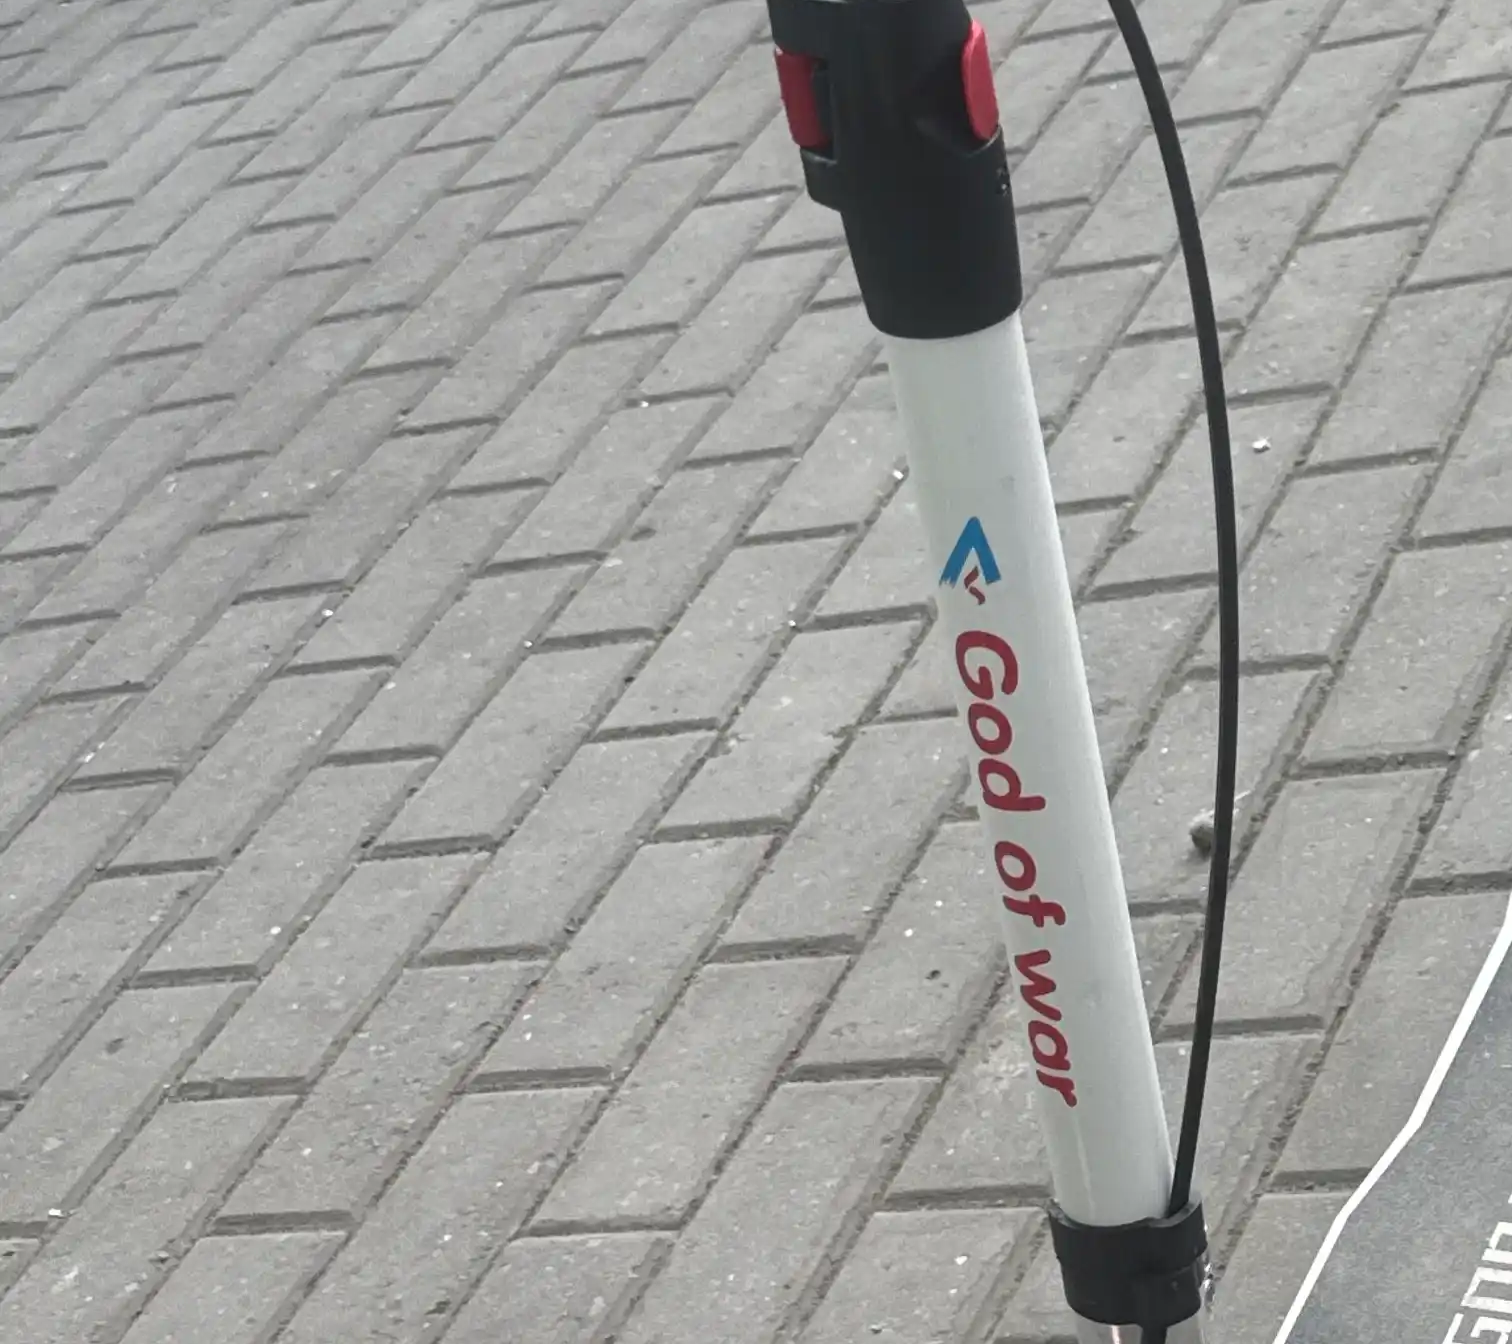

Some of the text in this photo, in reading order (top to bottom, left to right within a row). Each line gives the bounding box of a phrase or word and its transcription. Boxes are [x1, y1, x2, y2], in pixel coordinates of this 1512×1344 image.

[955, 630, 1077, 1108] God of war
